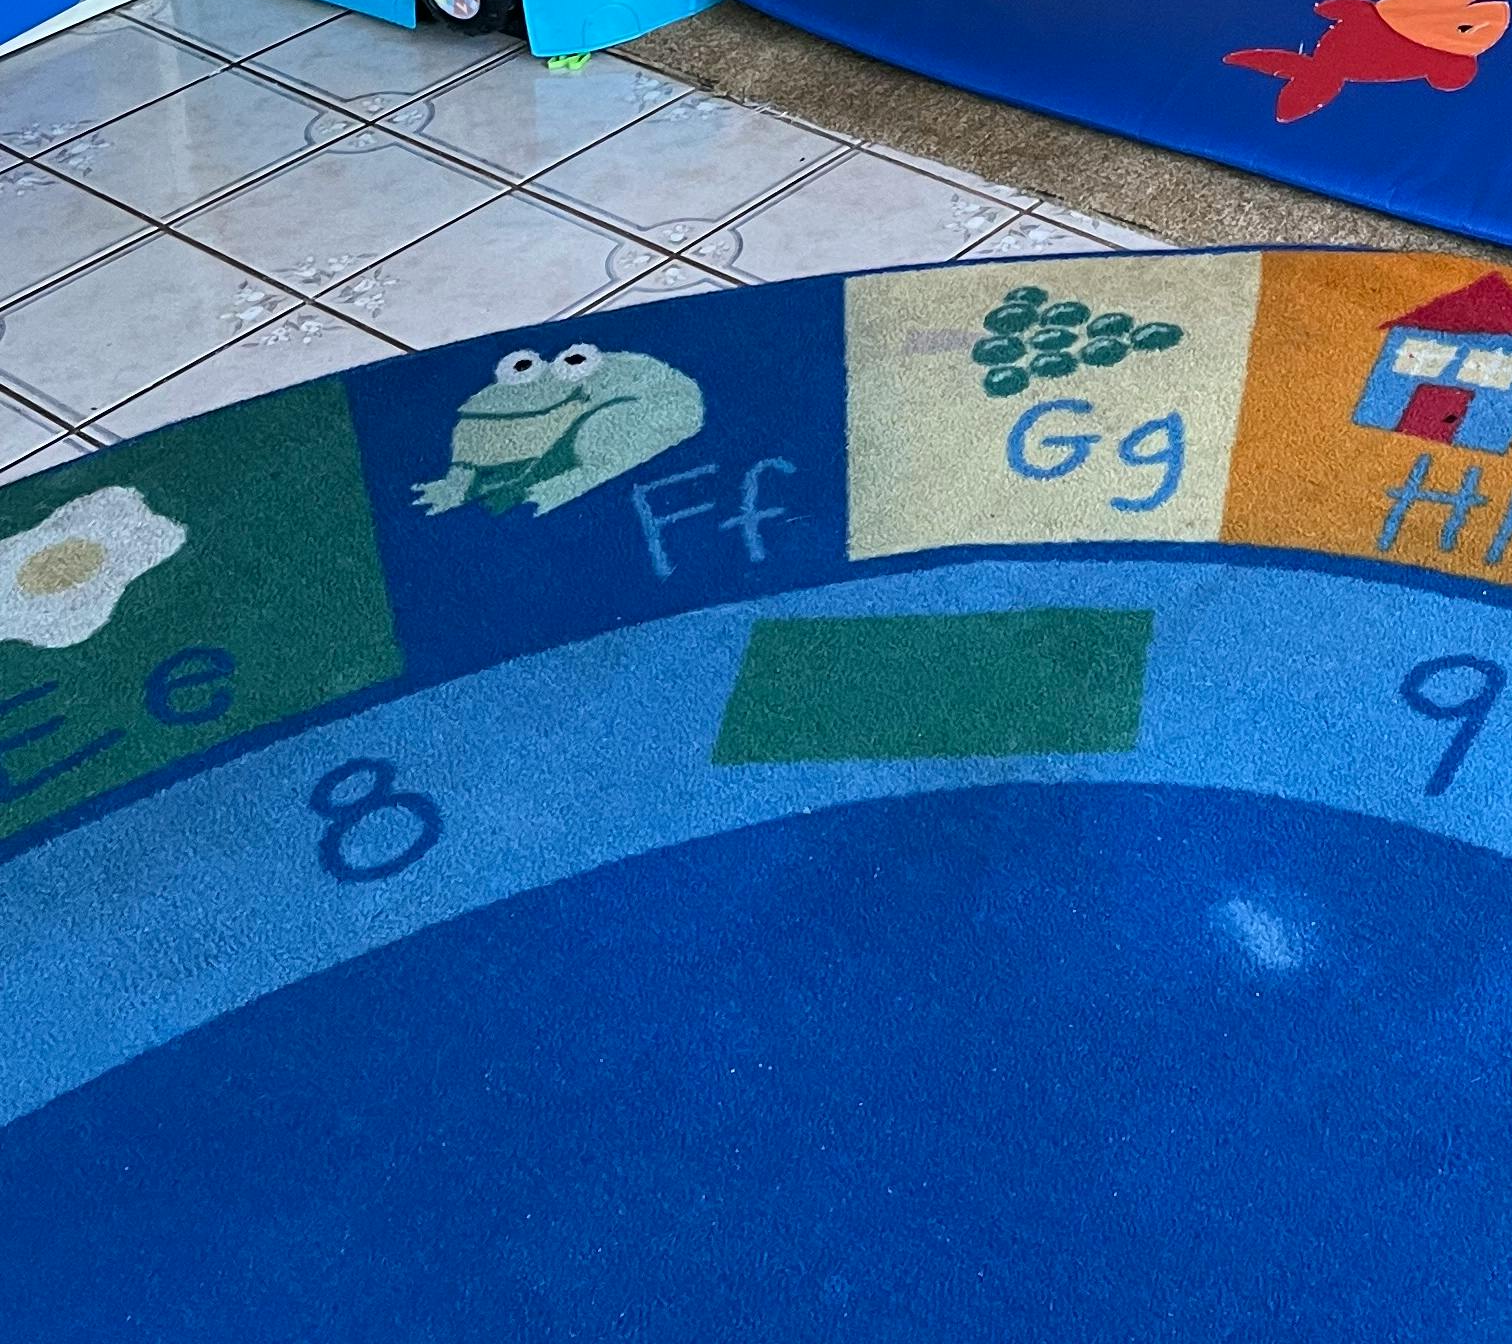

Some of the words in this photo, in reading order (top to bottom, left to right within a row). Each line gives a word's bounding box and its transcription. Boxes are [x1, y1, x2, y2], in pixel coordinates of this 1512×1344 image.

[1007, 399, 1183, 511] Gg
[633, 457, 796, 582] Ff
[1402, 654, 1507, 796] 9
[309, 758, 444, 884] 8
